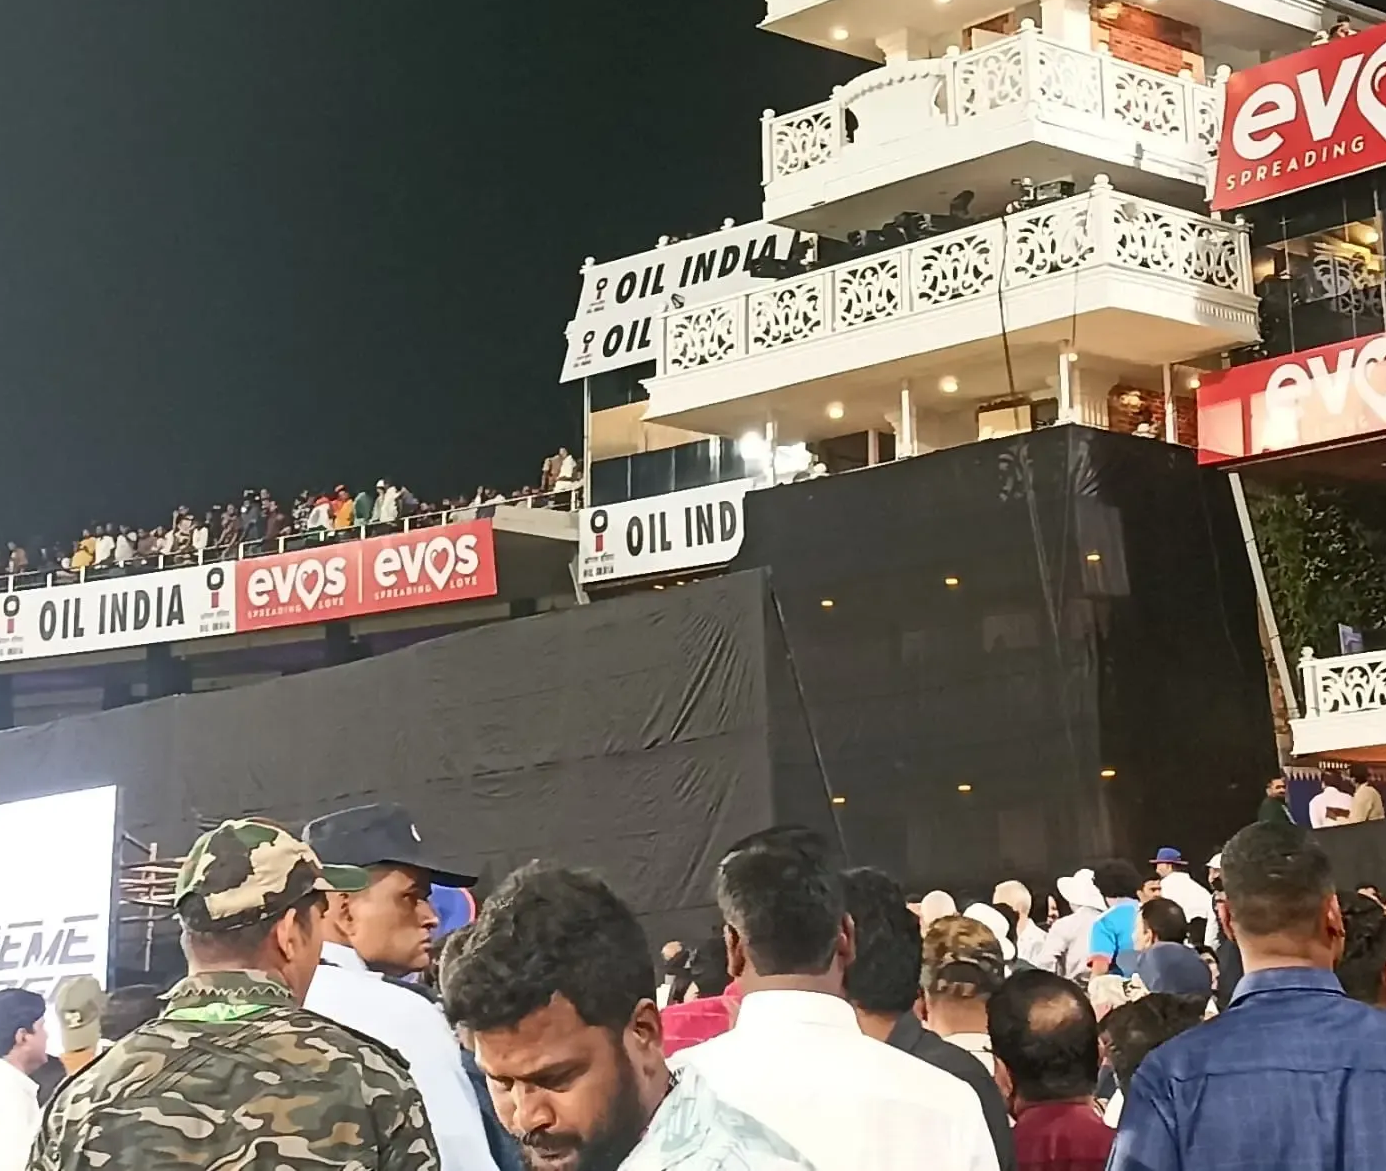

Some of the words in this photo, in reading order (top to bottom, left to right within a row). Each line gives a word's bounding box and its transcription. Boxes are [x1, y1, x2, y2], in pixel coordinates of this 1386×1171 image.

[1225, 135, 1365, 192] SPREADING
[615, 263, 665, 305] OIL
[679, 233, 779, 288] INDIA
[602, 316, 652, 358] OIL
[626, 512, 672, 556] OIL
[684, 500, 737, 547] IND
[247, 556, 347, 610] evos
[374, 534, 479, 591] evos
[450, 575, 478, 590] LOVE
[39, 598, 85, 642] OIL
[98, 584, 185, 635] INDIA
